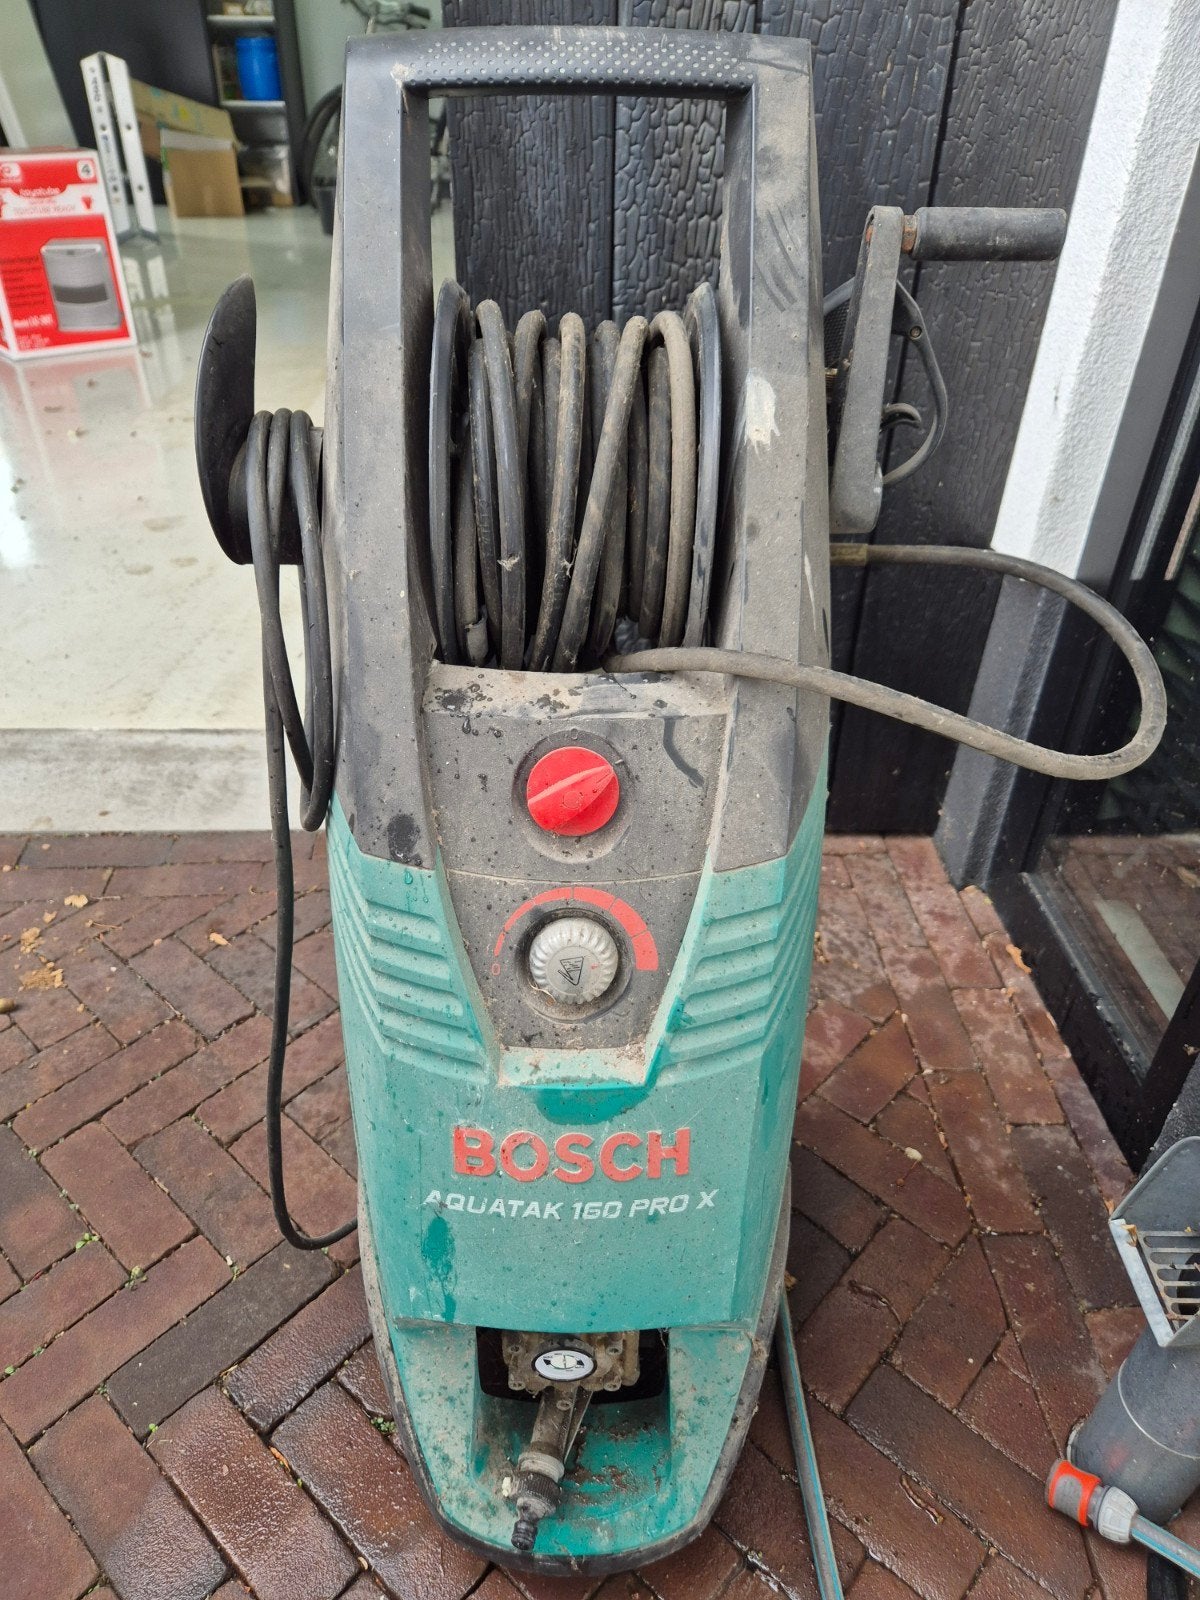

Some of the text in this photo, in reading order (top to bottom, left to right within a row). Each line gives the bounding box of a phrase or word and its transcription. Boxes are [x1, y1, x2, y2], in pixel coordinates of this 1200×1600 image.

[453, 1127, 691, 1184] BOSCH
[425, 1189, 720, 1220] AQUATAK 160 PRO X
